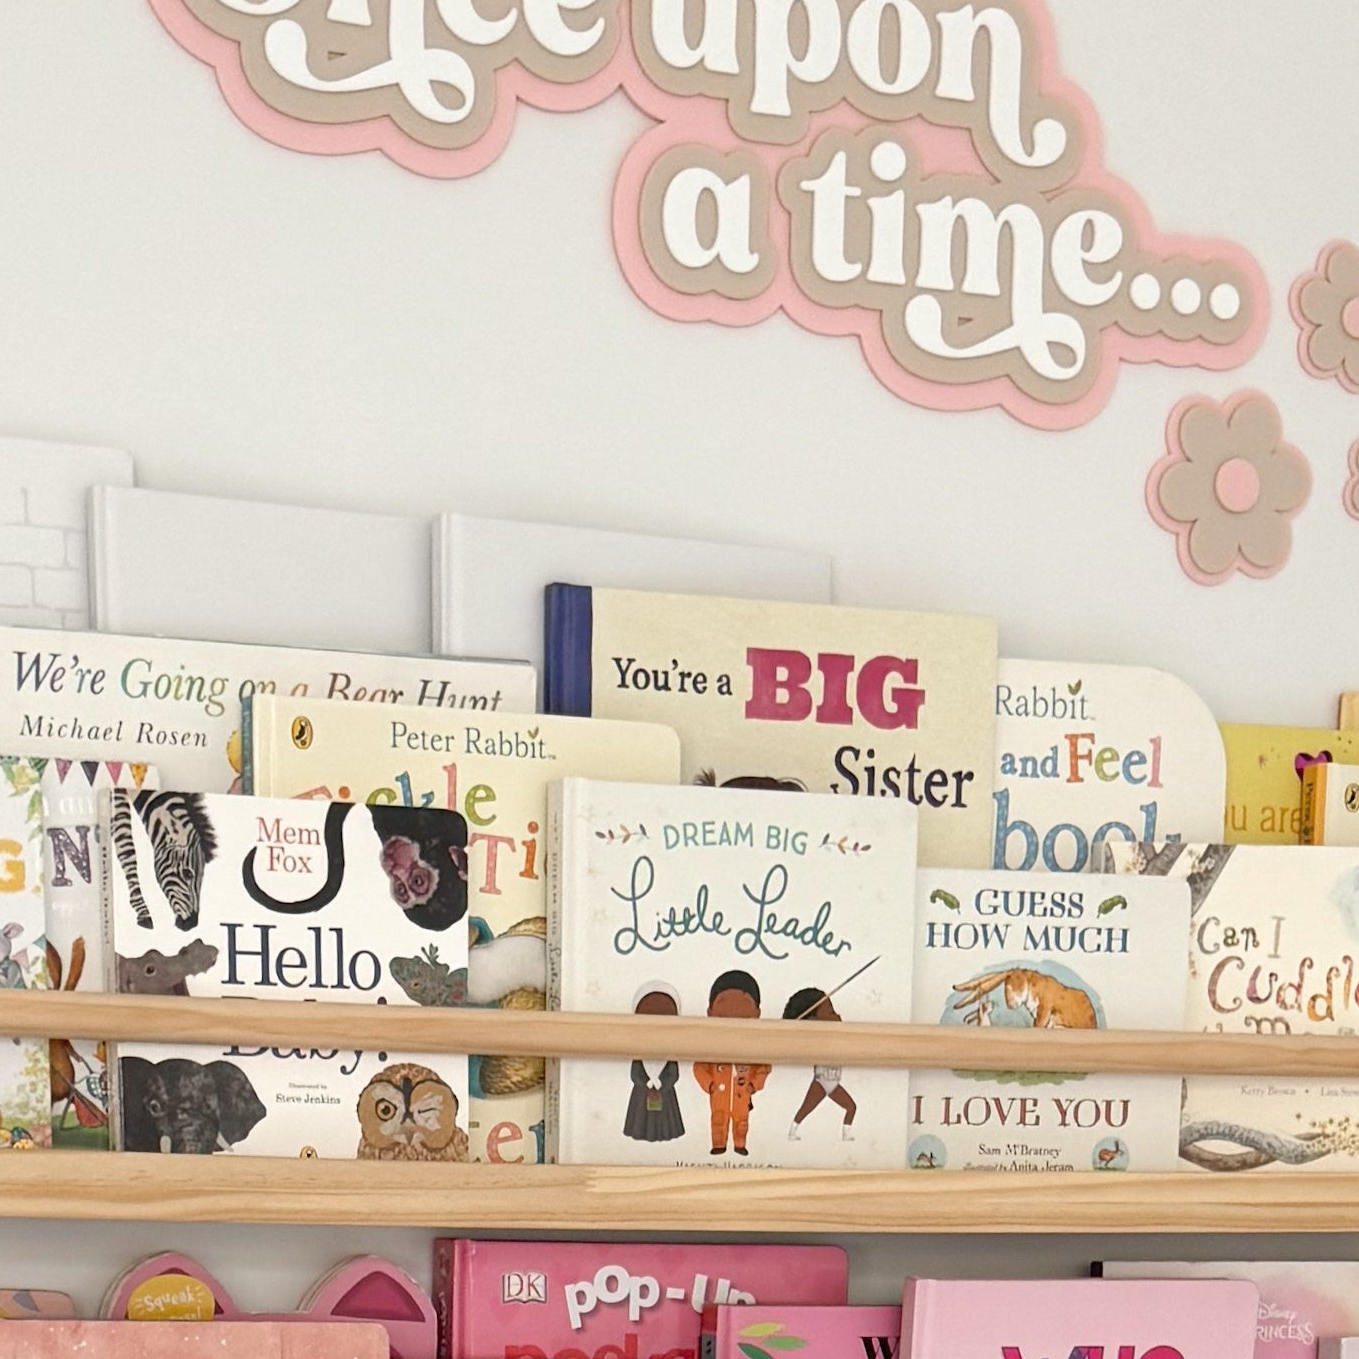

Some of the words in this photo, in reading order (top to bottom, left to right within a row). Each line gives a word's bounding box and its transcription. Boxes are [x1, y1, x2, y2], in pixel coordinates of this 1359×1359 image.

[648, 0, 1068, 167] upon
[660, 167, 761, 274] a
[798, 141, 1241, 381] time...
[612, 657, 721, 694] You're
[717, 673, 733, 696] a
[745, 647, 925, 729] BIG
[19, 715, 122, 742] Michael
[137, 722, 208, 747] Rosen
[1001, 746, 1059, 778] and
[1065, 733, 1164, 788] Feel
[256, 817, 320, 847] Mem
[664, 821, 754, 851] DREAM
[767, 824, 808, 854] BIG
[266, 847, 312, 874] Fox
[975, 888, 1084, 918] GUESS
[926, 922, 1009, 950] HOW
[1023, 925, 1130, 953] MUCH
[220, 922, 383, 991] Hello
[913, 1095, 924, 1124] I
[941, 1096, 1041, 1126] LOVE
[1052, 1097, 1130, 1128] YOU
[143, 1289, 196, 1311] Squeak
